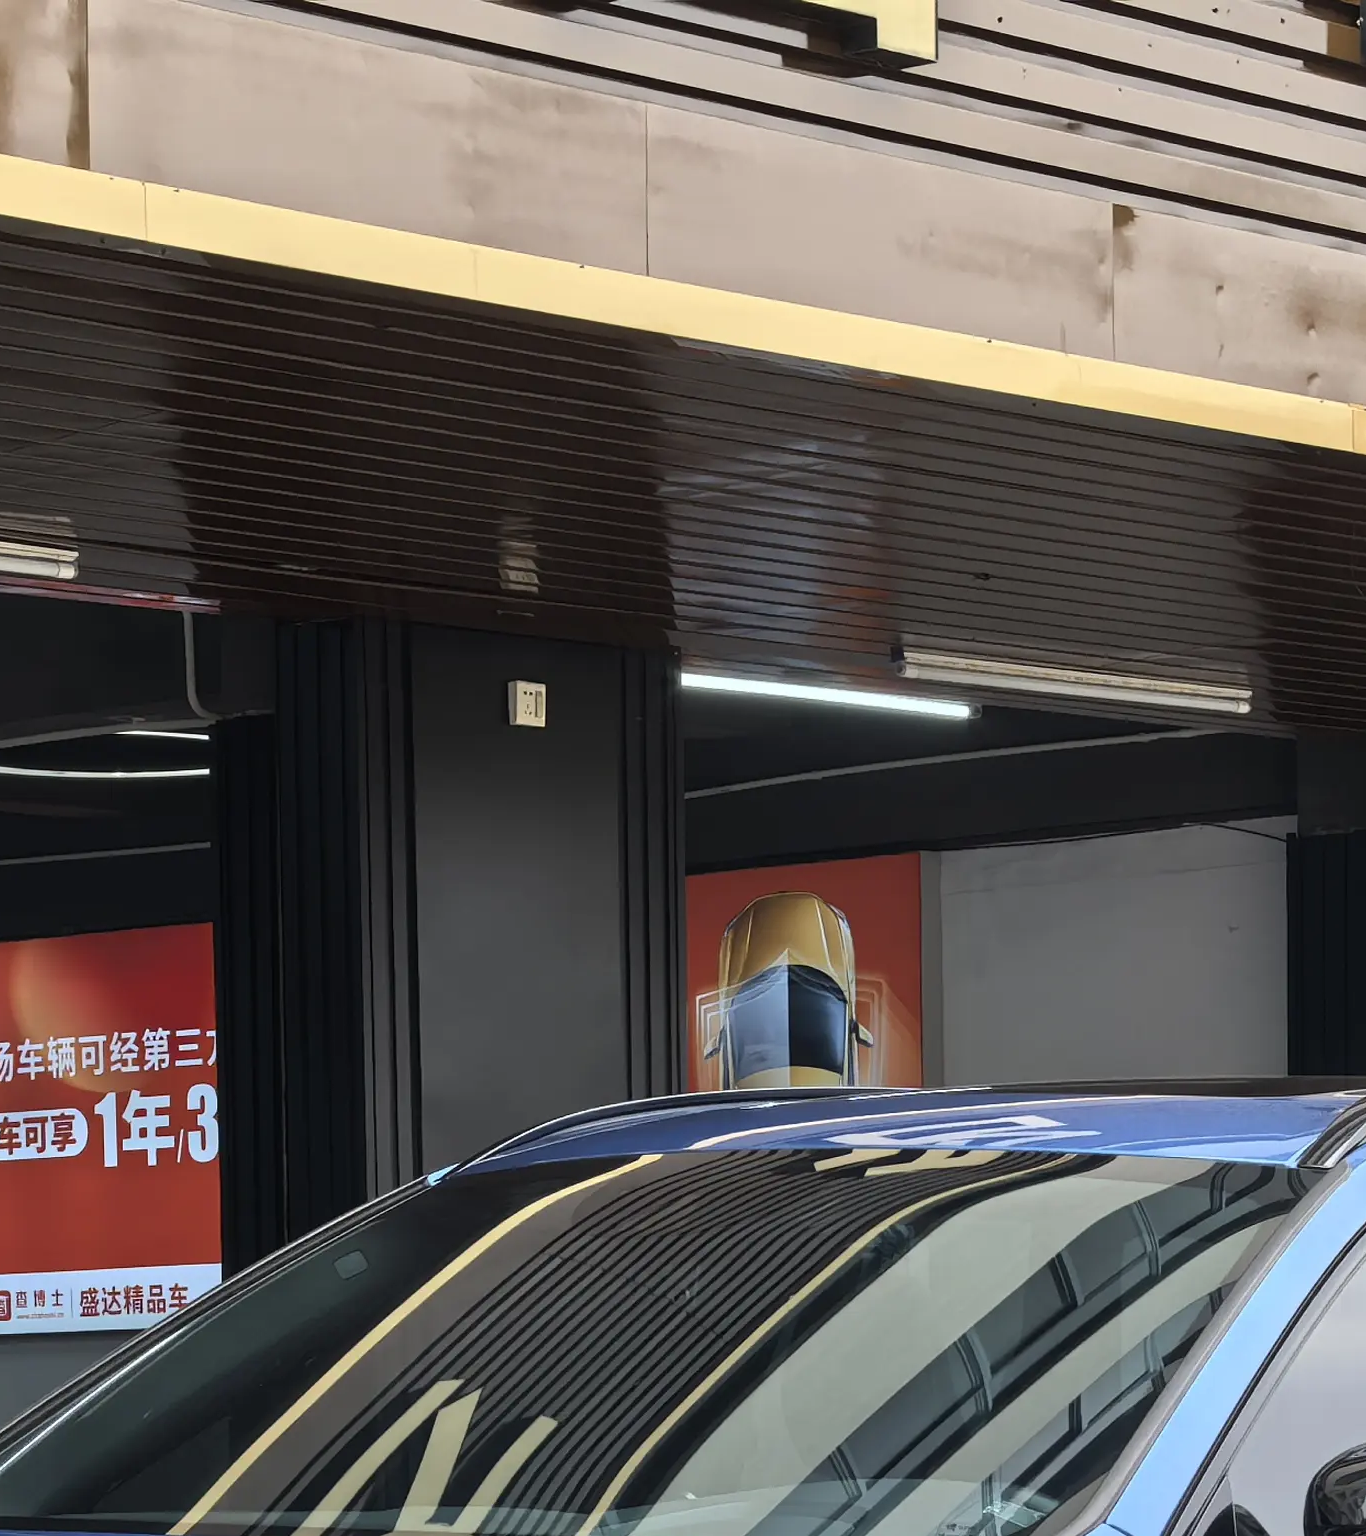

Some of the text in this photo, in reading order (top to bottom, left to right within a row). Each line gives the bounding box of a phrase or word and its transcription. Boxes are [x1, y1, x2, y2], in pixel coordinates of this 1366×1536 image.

[16, 1289, 64, 1308] 查博士
[80, 1283, 189, 1317] 盛达精品车
